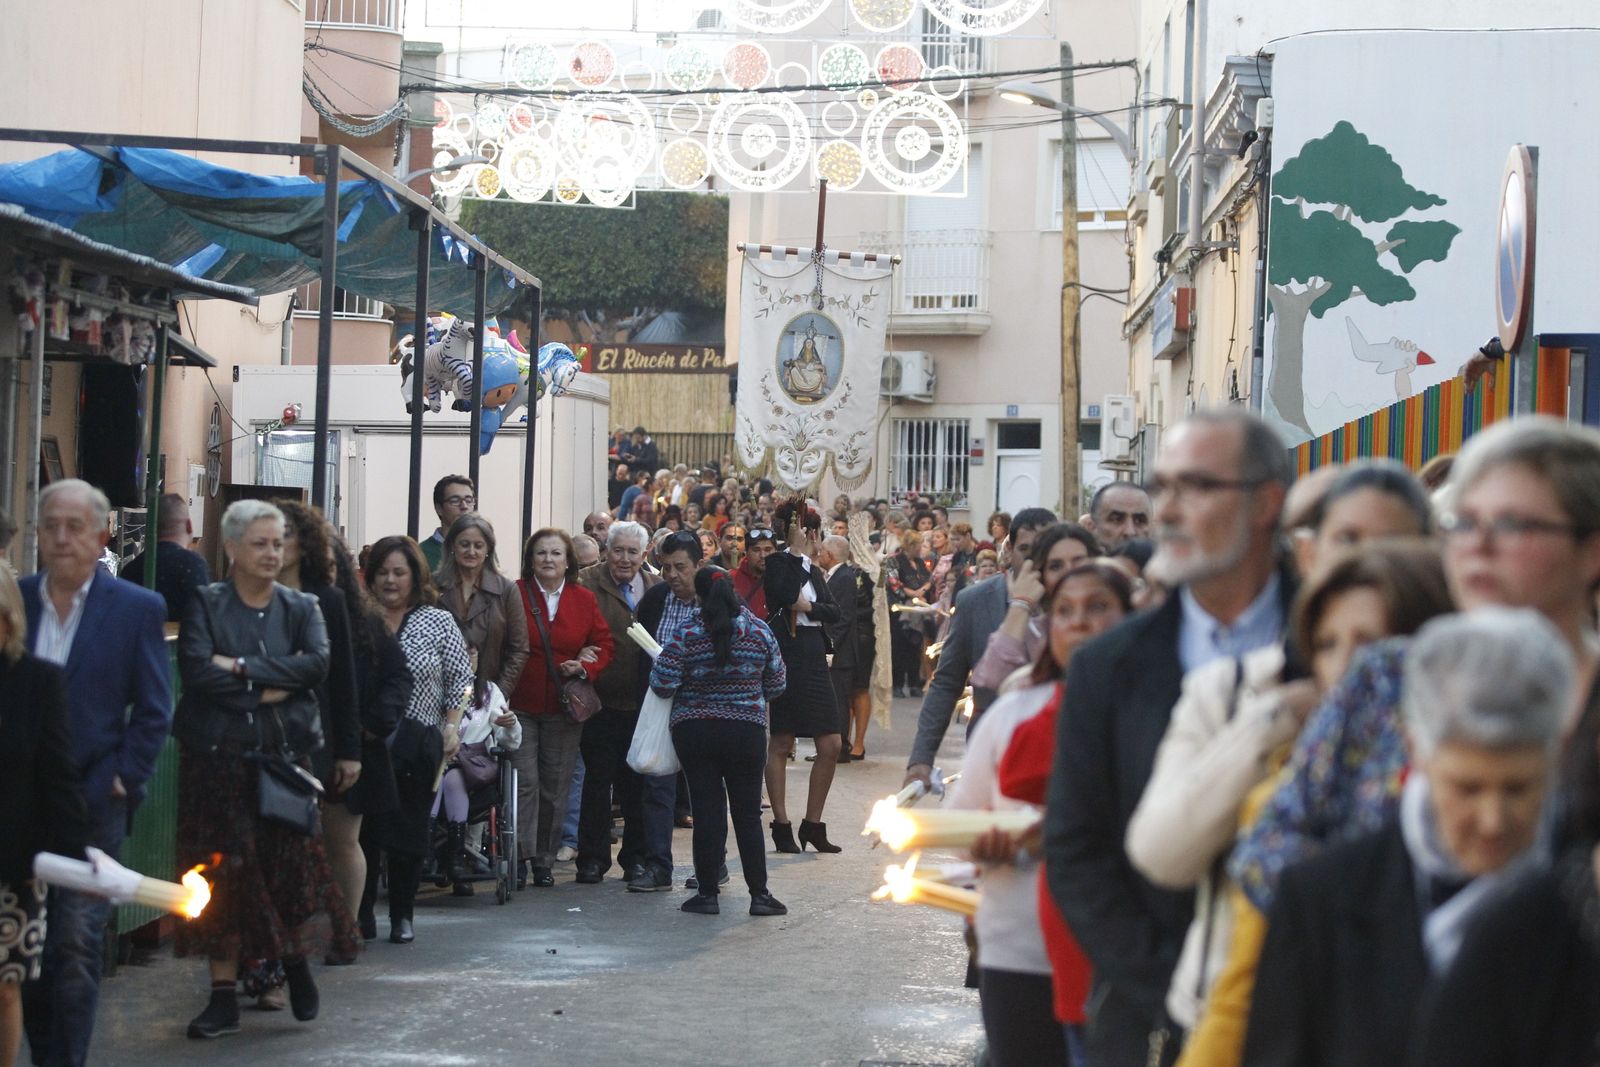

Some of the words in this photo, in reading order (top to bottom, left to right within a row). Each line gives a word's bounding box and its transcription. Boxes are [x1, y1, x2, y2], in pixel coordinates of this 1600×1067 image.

[597, 347, 618, 370] El
[623, 347, 676, 369] Rincón
[679, 348, 698, 368] de
